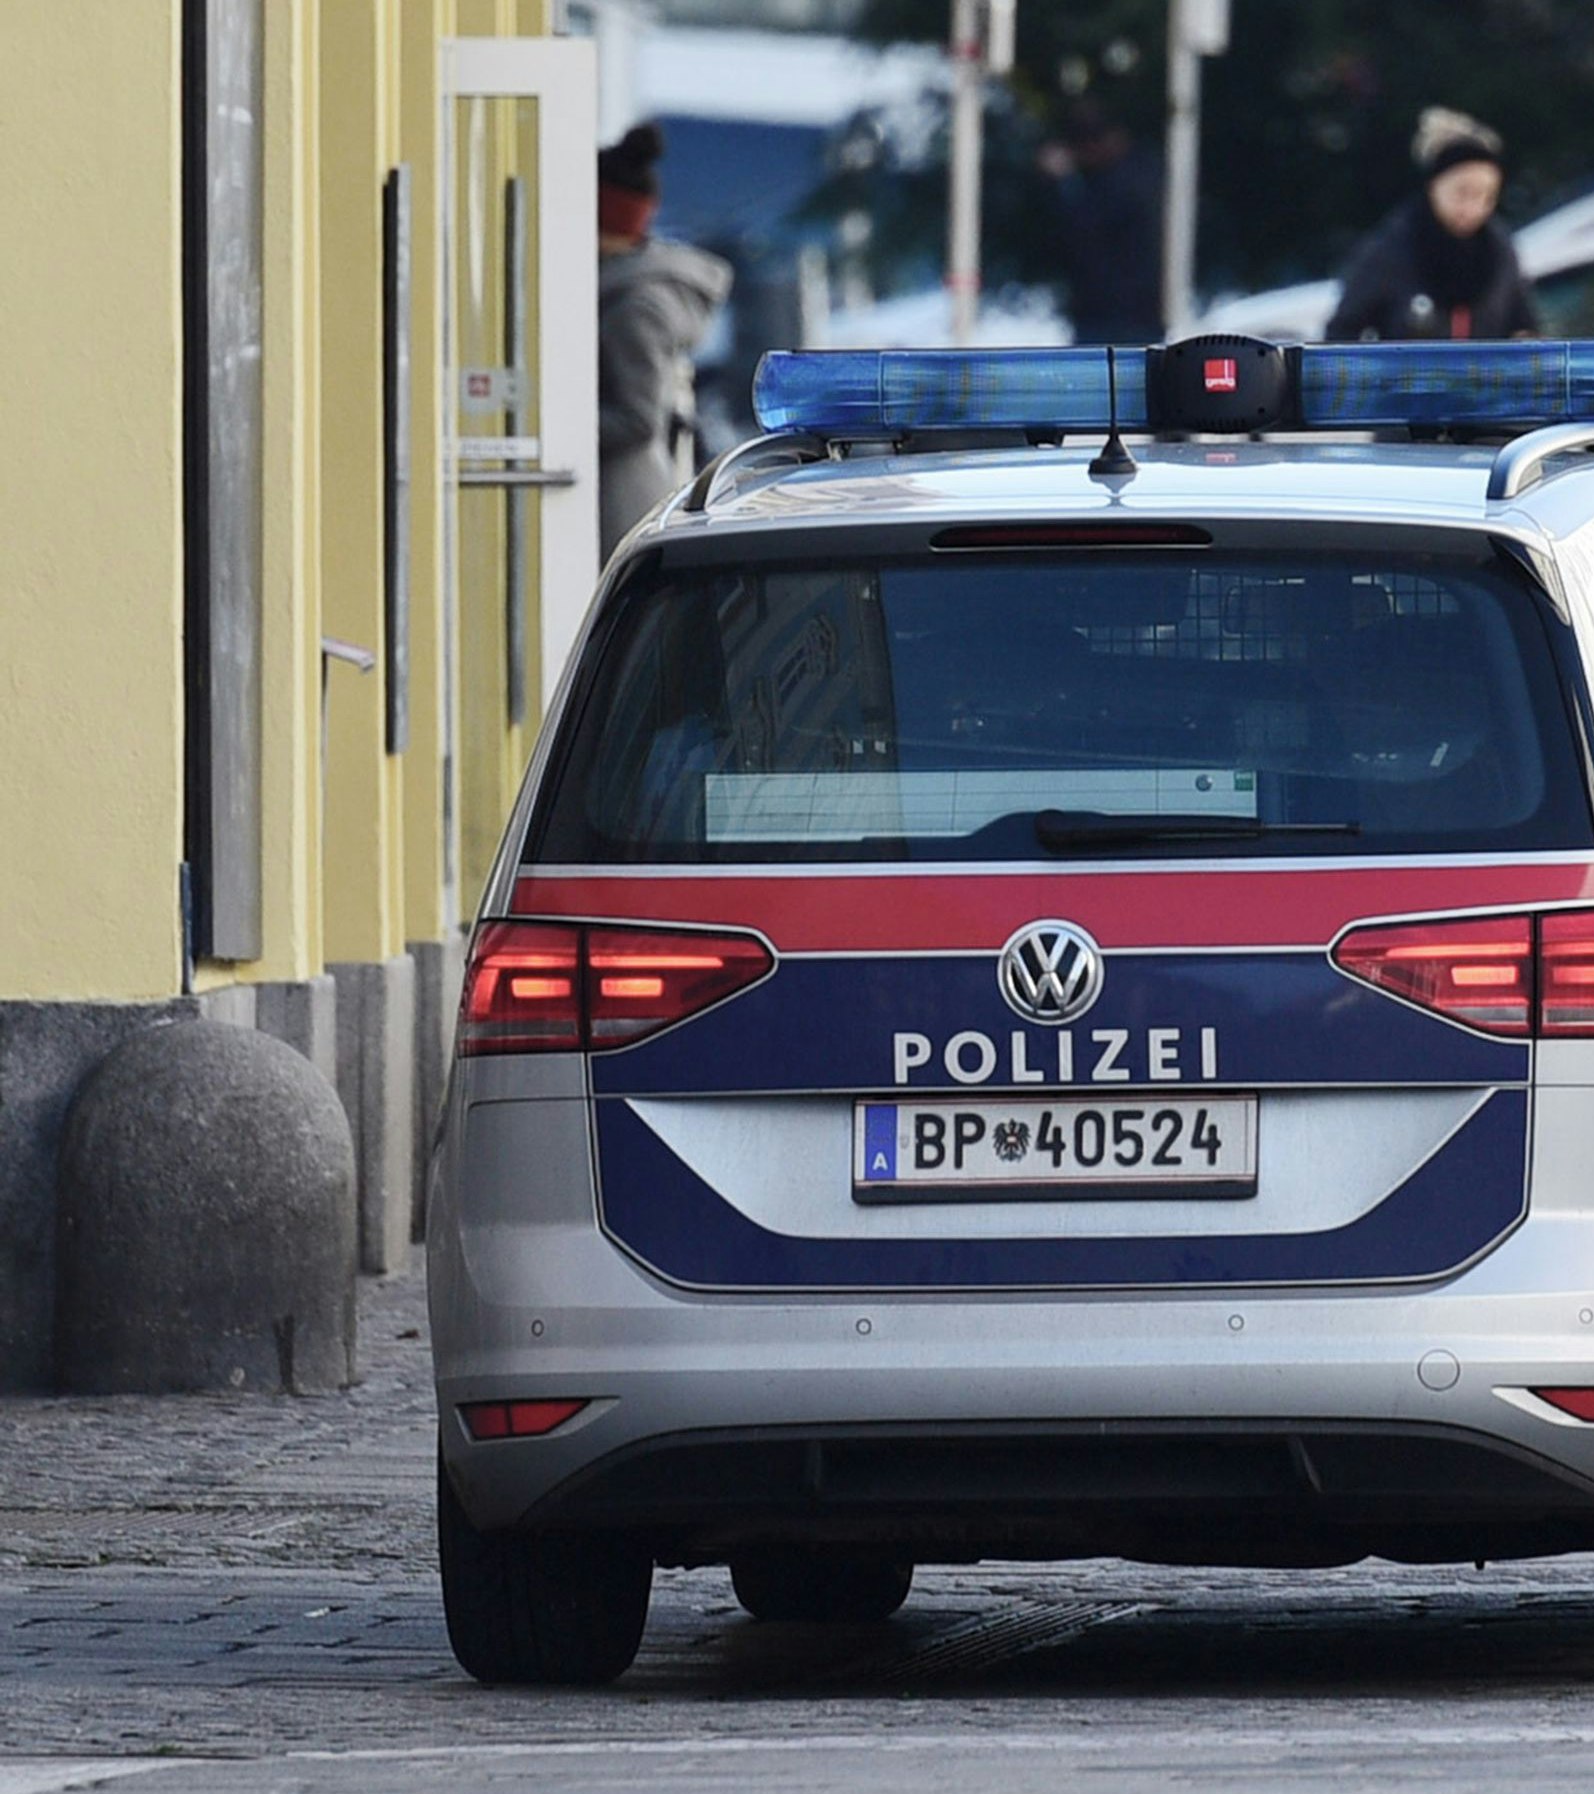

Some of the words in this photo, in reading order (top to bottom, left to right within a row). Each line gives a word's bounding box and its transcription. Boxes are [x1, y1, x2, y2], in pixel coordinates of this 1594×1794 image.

[1002, 923, 1098, 1018] VW
[893, 1027, 1216, 1084] POLIZEI
[872, 1151, 888, 1171] A
[914, 1112, 986, 1170] BP
[1036, 1108, 1222, 1168] 40524
